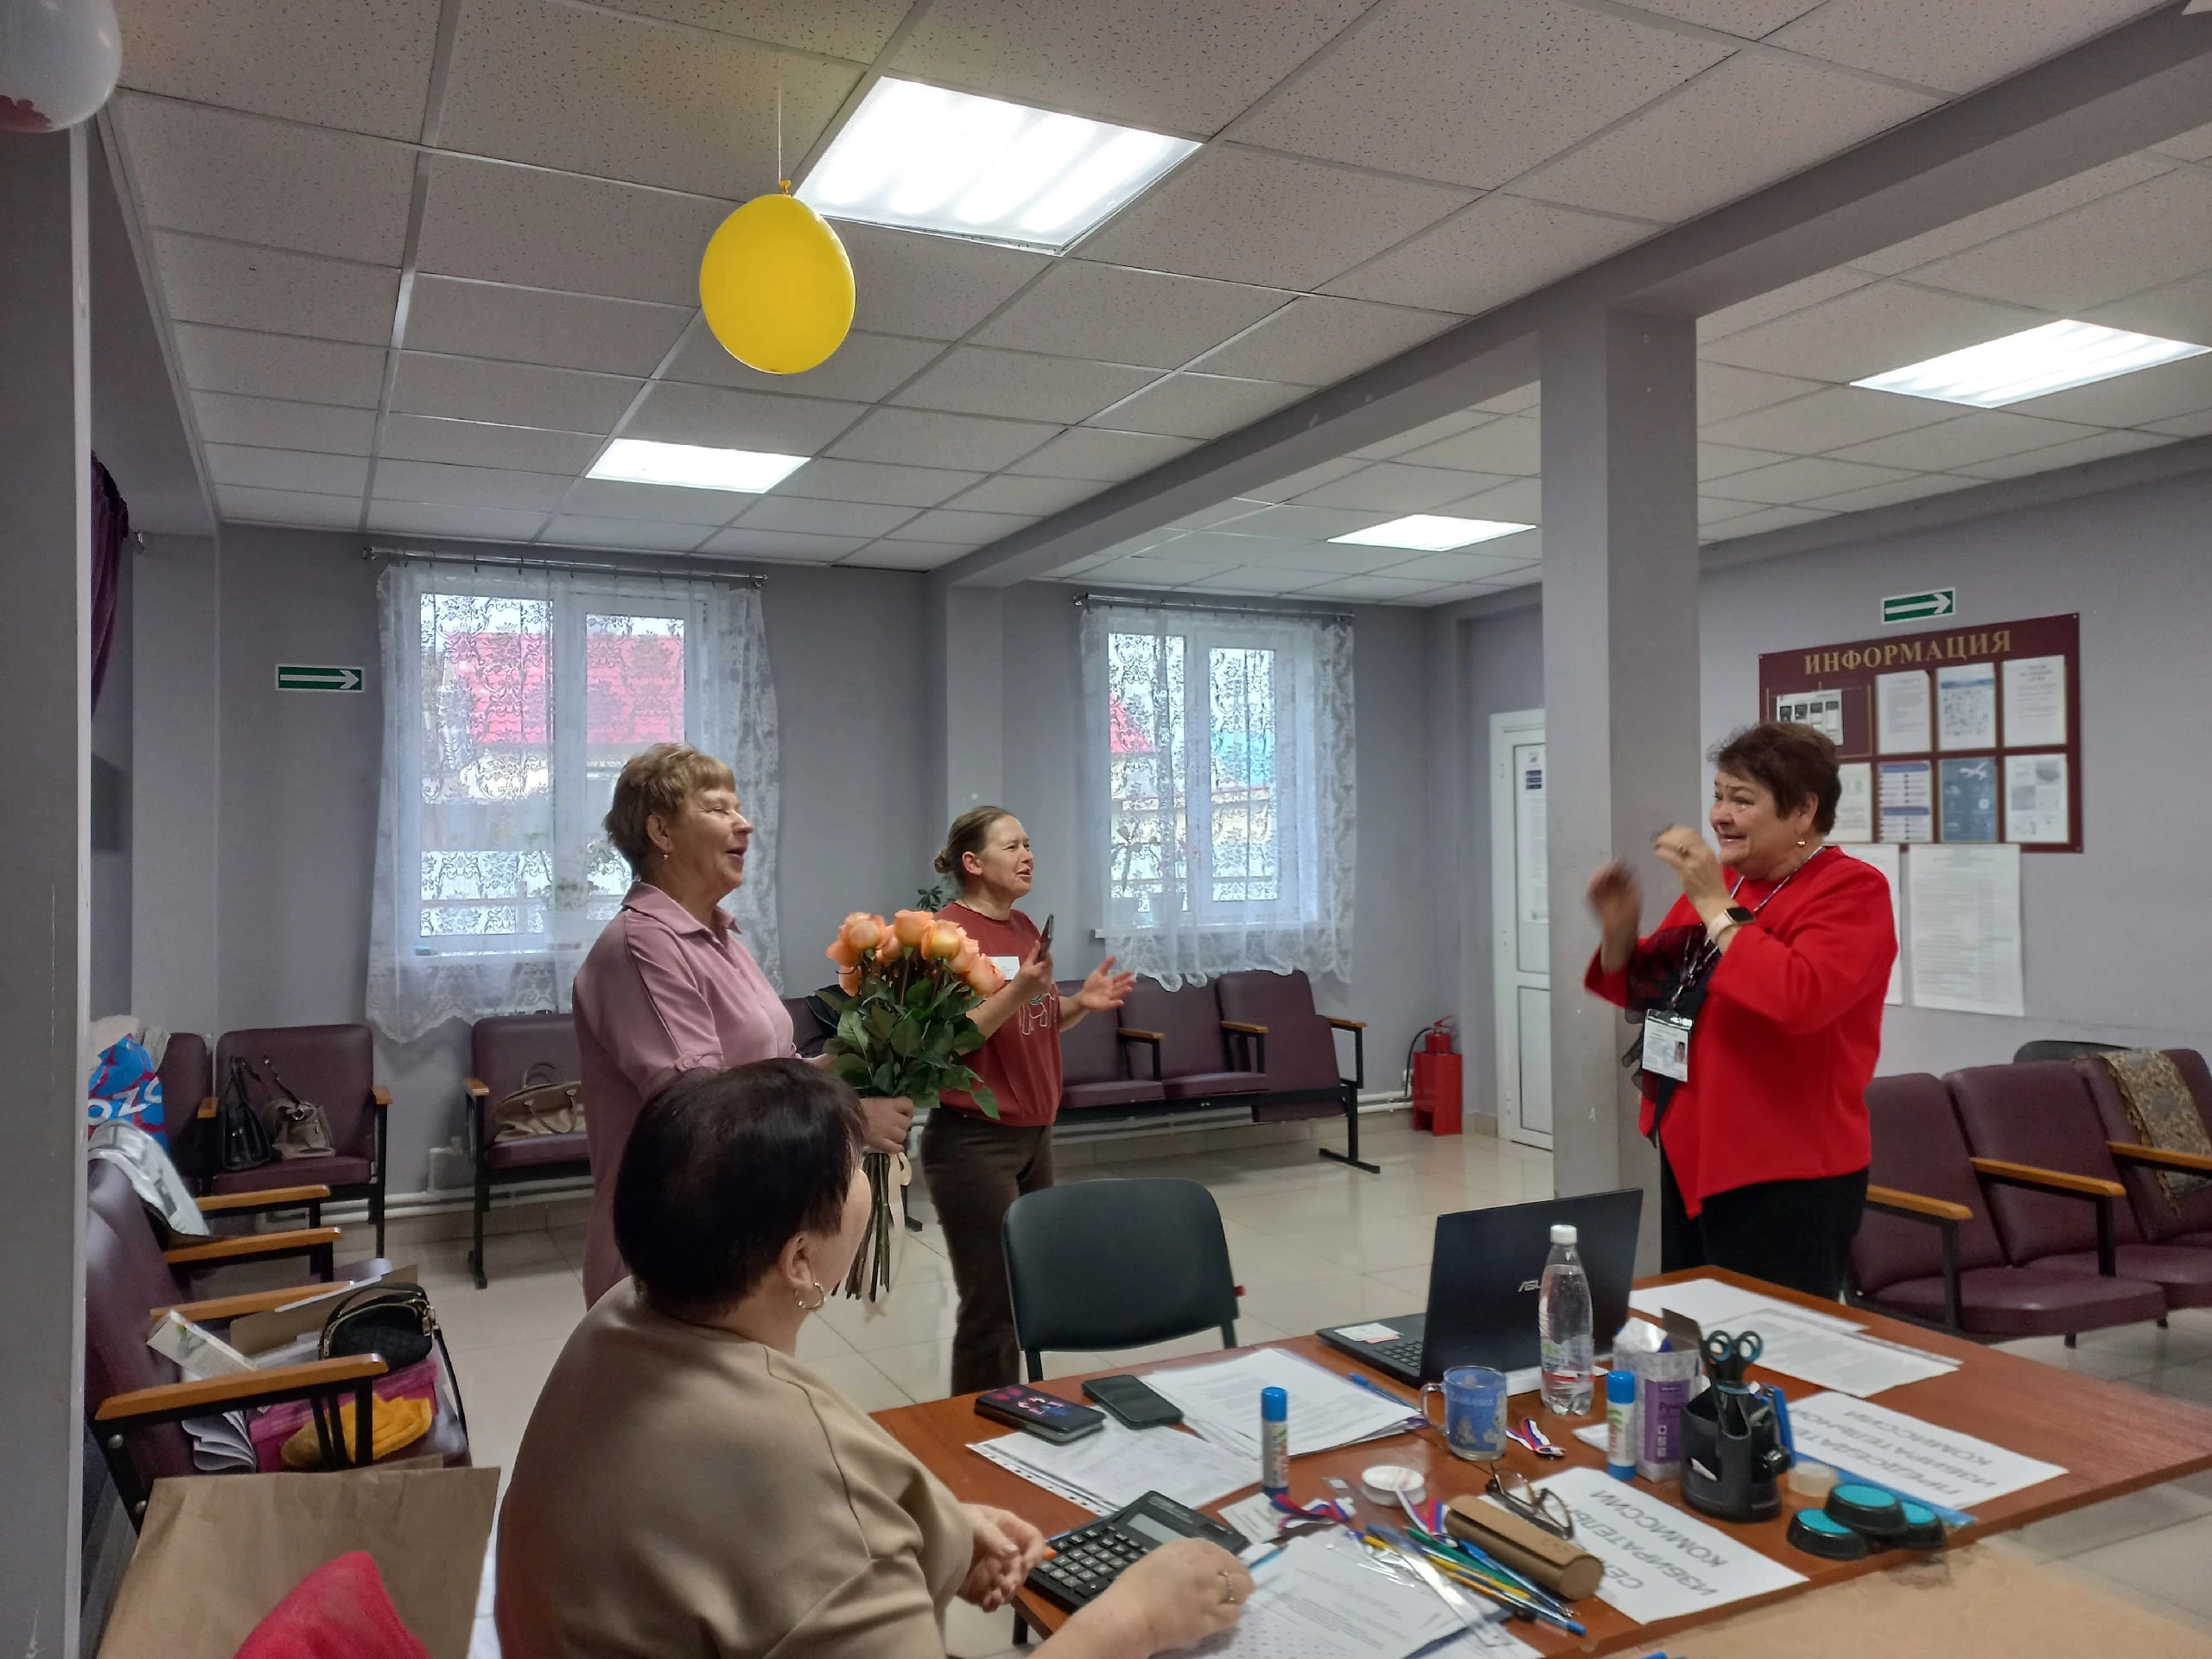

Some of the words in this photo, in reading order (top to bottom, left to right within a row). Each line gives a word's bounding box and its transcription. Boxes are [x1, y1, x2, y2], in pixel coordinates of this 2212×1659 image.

[1804, 630, 2011, 675] ИНФОРМАЦИЯ
[88, 1076, 162, 1126] OZO
[1518, 1280, 1541, 1293] ASU
[1791, 1426, 1963, 1495] ПРЕДСЕДАТЕ
[1843, 1409, 1993, 1466] КОМИССИИ
[1570, 1509, 1718, 1597] ИЗБИРАТЕЛЬ
[1590, 1490, 1729, 1568] КОМИССИИ
